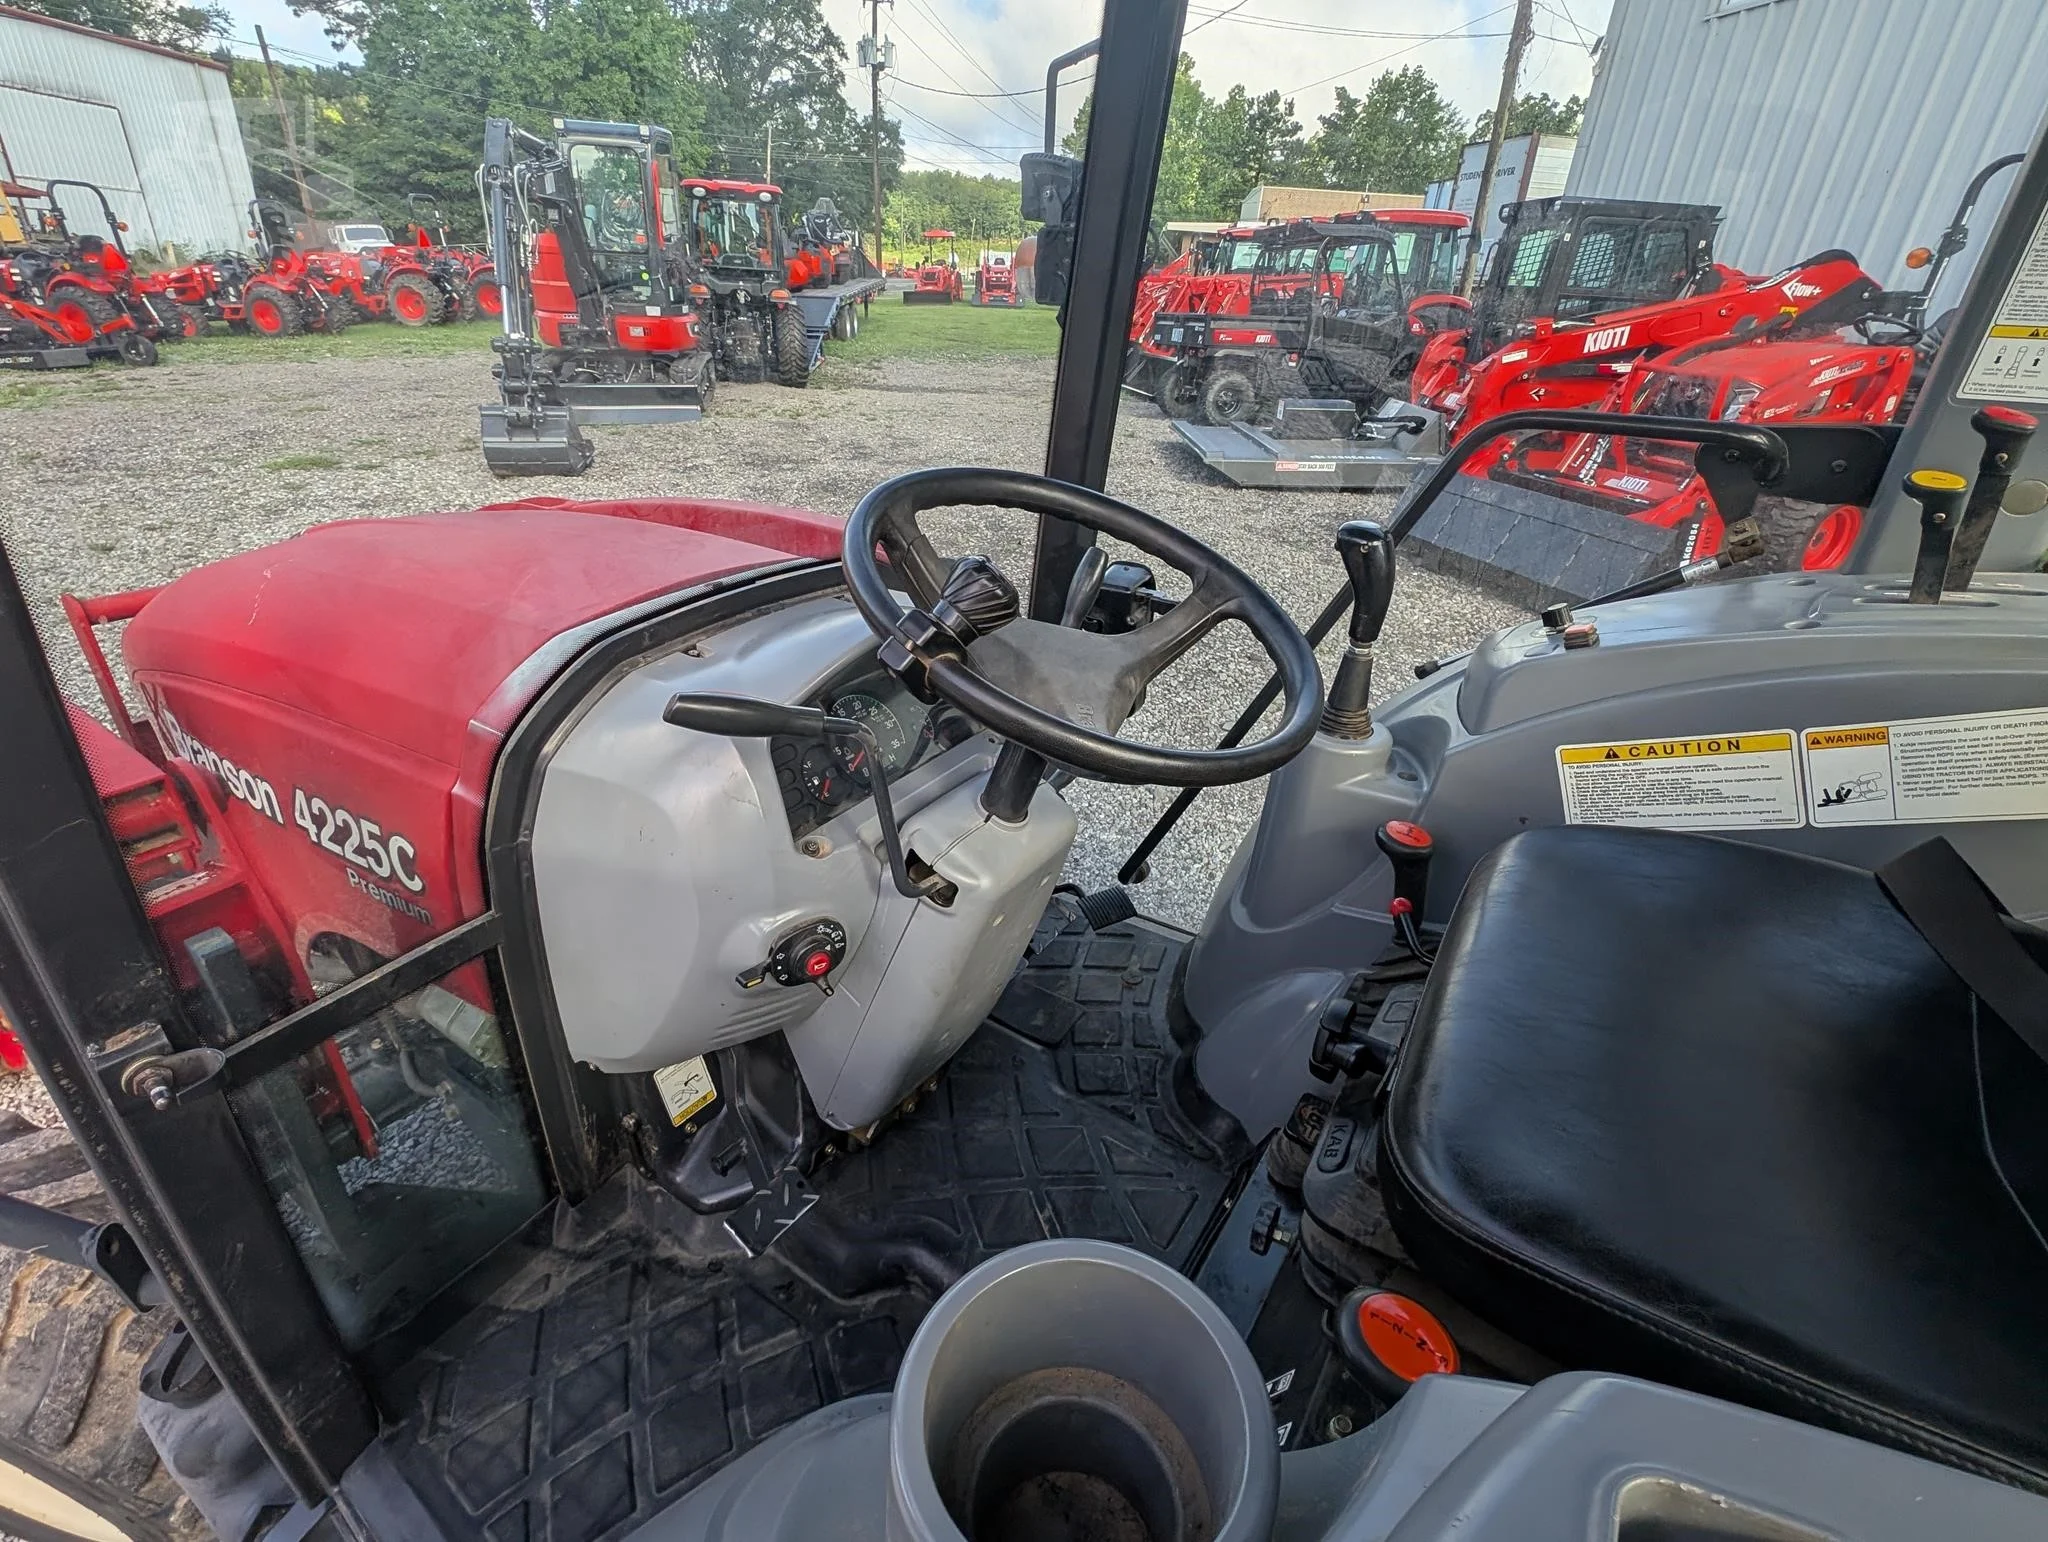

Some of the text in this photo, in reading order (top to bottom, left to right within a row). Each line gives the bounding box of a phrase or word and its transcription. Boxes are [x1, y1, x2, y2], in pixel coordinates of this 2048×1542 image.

[1495, 166, 1516, 177] RIVER
[1583, 325, 1631, 354] KIOTI
[1617, 475, 1650, 491] KIOTI
[852, 700, 861, 710] 20
[1824, 731, 1887, 745] WARNING
[1924, 727, 1962, 735] PERSONAL
[890, 738, 900, 748] 35
[1628, 738, 1741, 758] CAUTION
[163, 708, 285, 826] Branson
[293, 786, 425, 893] 4225C
[345, 867, 432, 924] Premium
[1322, 1123, 1352, 1160] KAB
